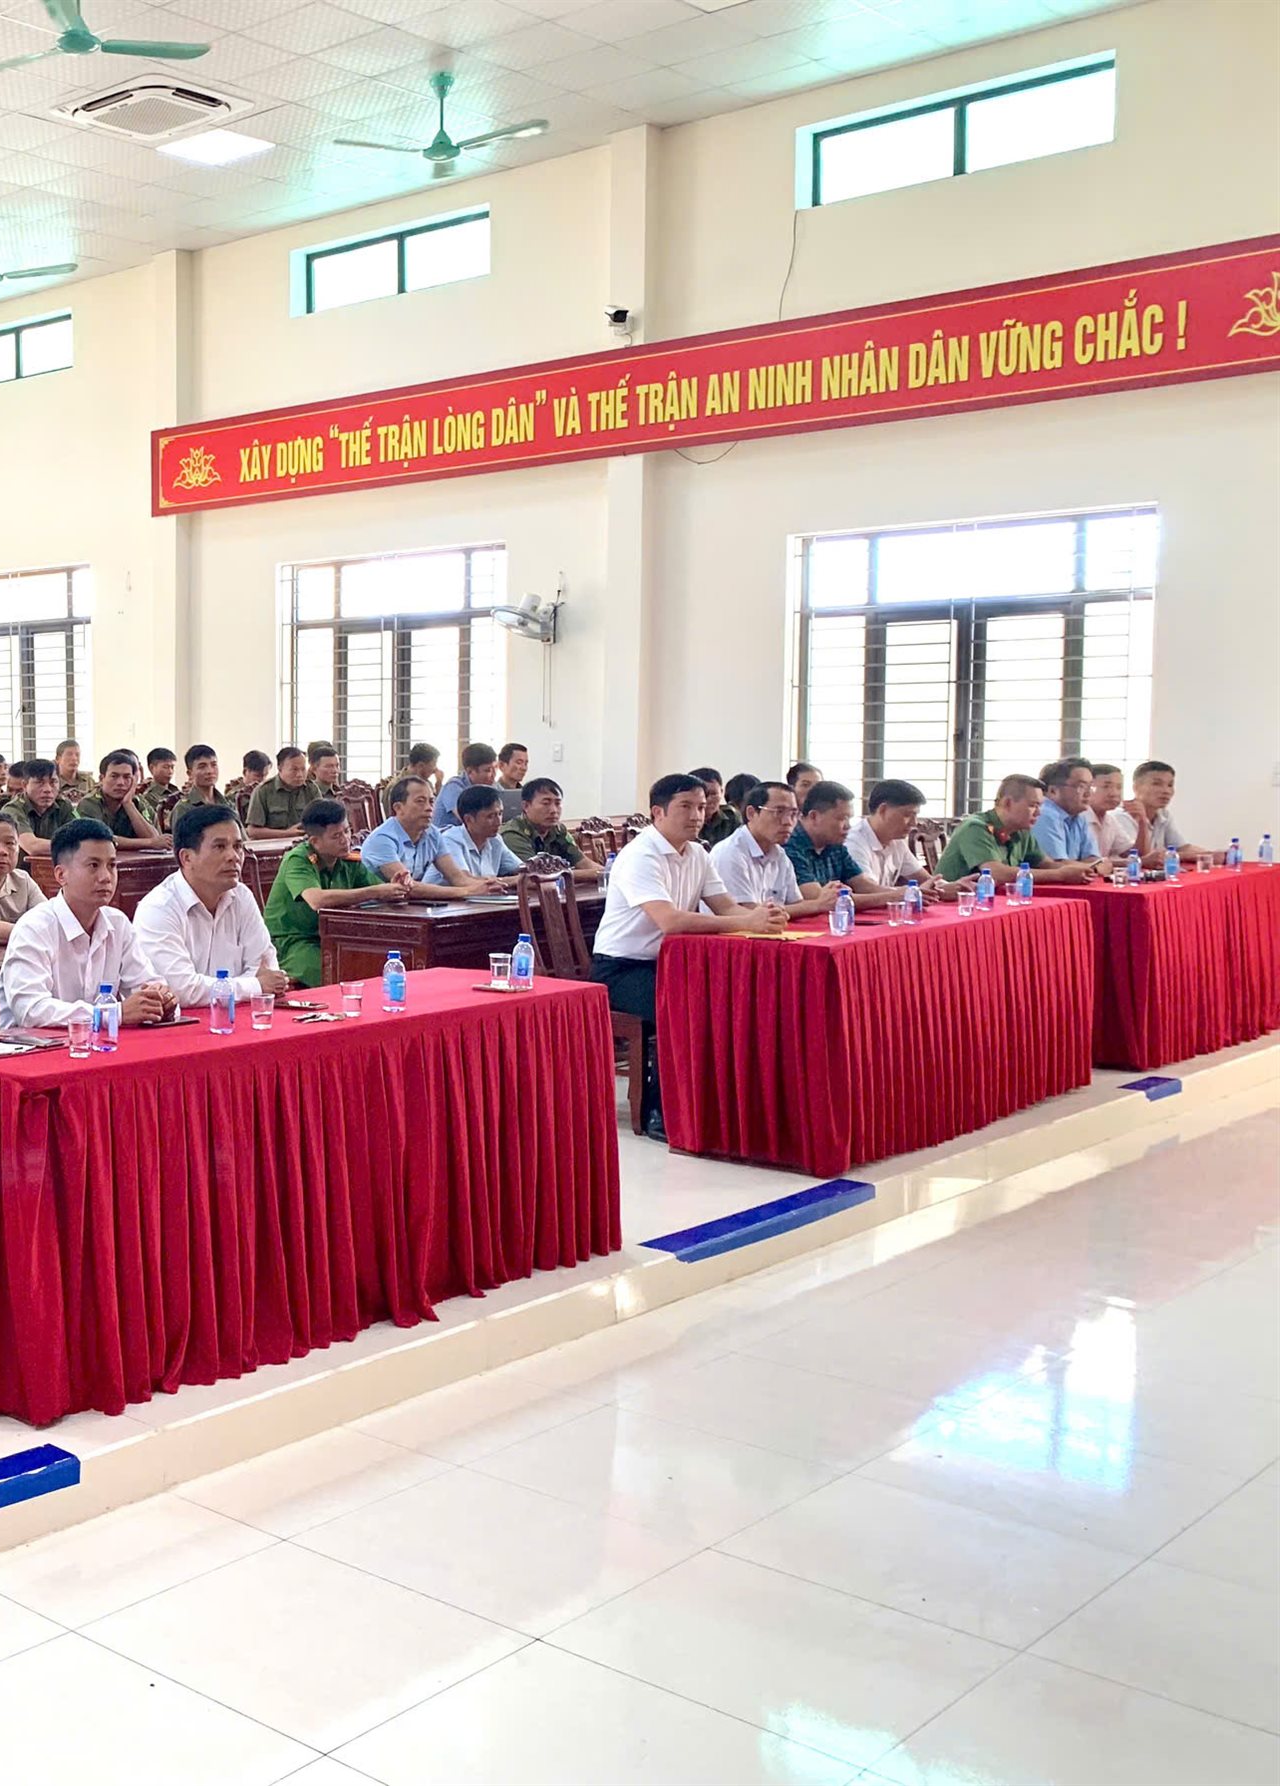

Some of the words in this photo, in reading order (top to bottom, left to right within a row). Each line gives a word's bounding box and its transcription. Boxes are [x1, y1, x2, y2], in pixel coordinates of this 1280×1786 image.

[239, 440, 271, 482] XÂY
[276, 434, 323, 483] DỰNG
[377, 415, 428, 466] TRẬN
[432, 405, 485, 454] LÒNG
[553, 387, 581, 437] VÀ
[587, 373, 631, 432] THẾ
[636, 371, 698, 430] TRẬN
[705, 370, 740, 416] AN
[747, 359, 812, 411] NINH
[821, 340, 899, 401] NHÂN
[908, 329, 970, 390] DÂN
[979, 317, 1064, 379] VỮNG
[1074, 287, 1164, 366] CHẮC
[1176, 300, 1188, 350] !
